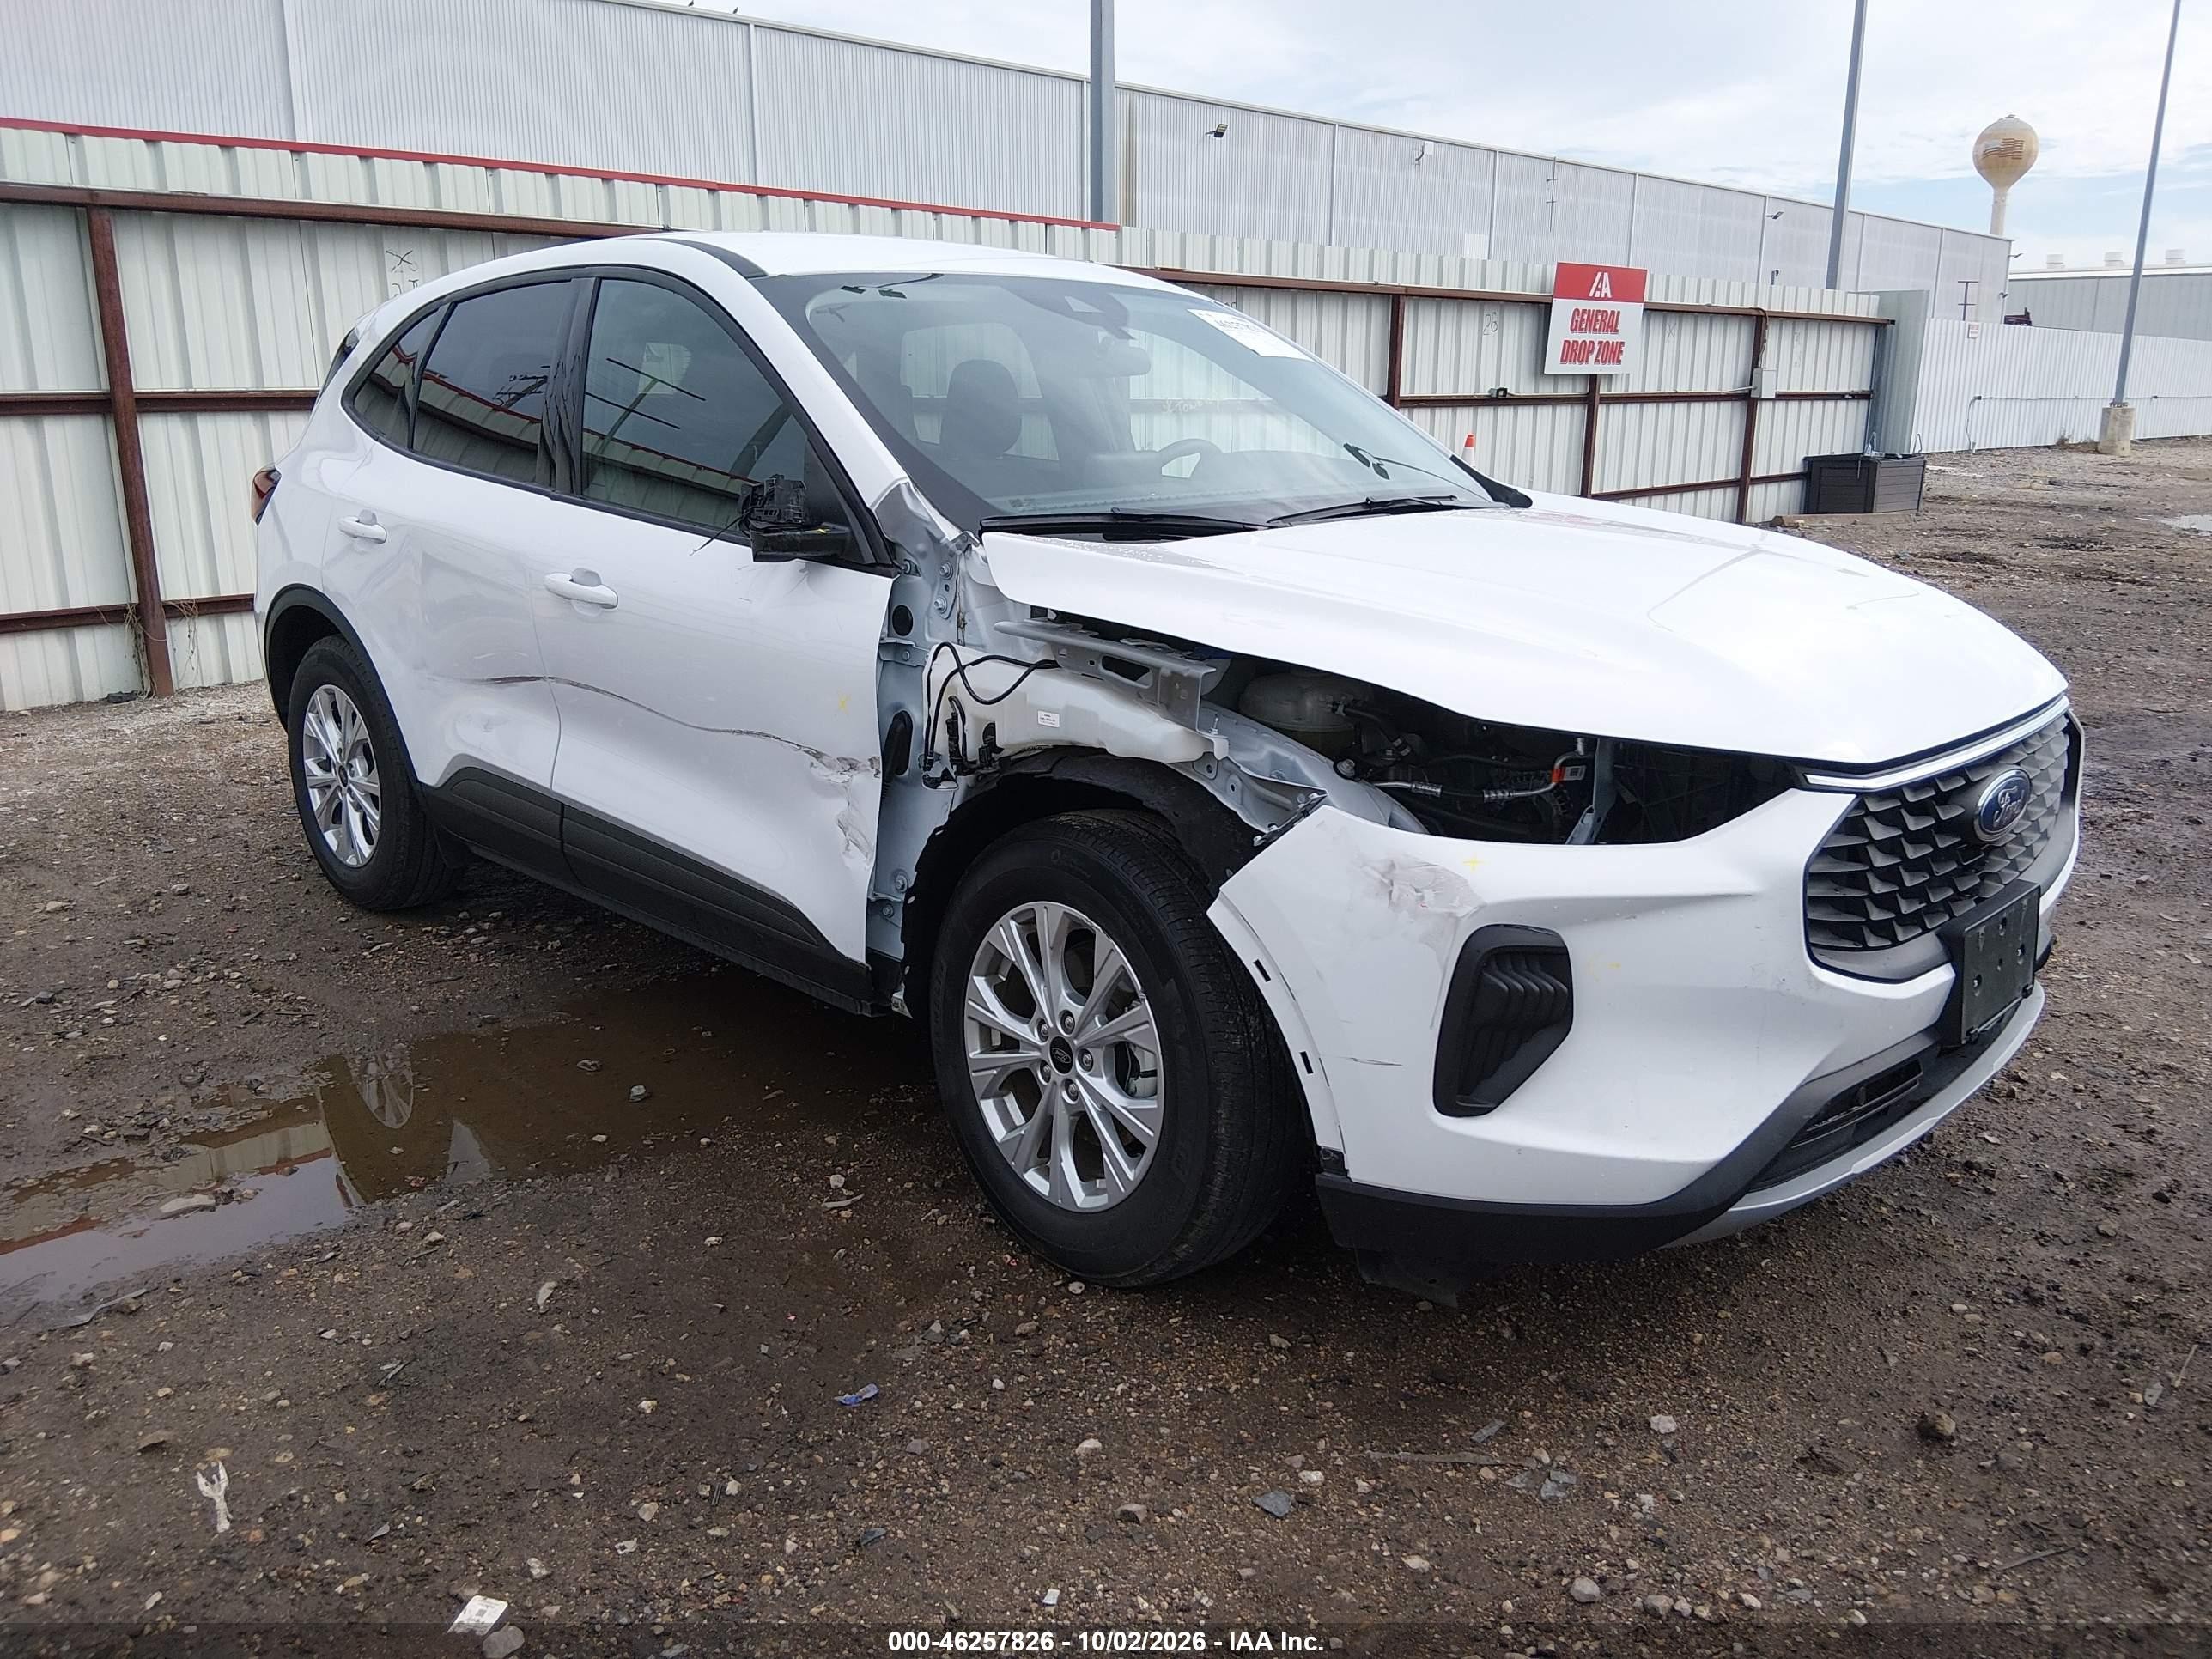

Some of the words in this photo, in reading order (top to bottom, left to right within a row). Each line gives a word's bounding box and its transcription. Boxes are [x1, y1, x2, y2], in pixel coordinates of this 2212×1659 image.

[1570, 307, 1621, 335] GENERAL
[1560, 339, 1595, 365] DROP
[1593, 340, 1625, 365] ZONE
[1992, 785, 2025, 828] Ford
